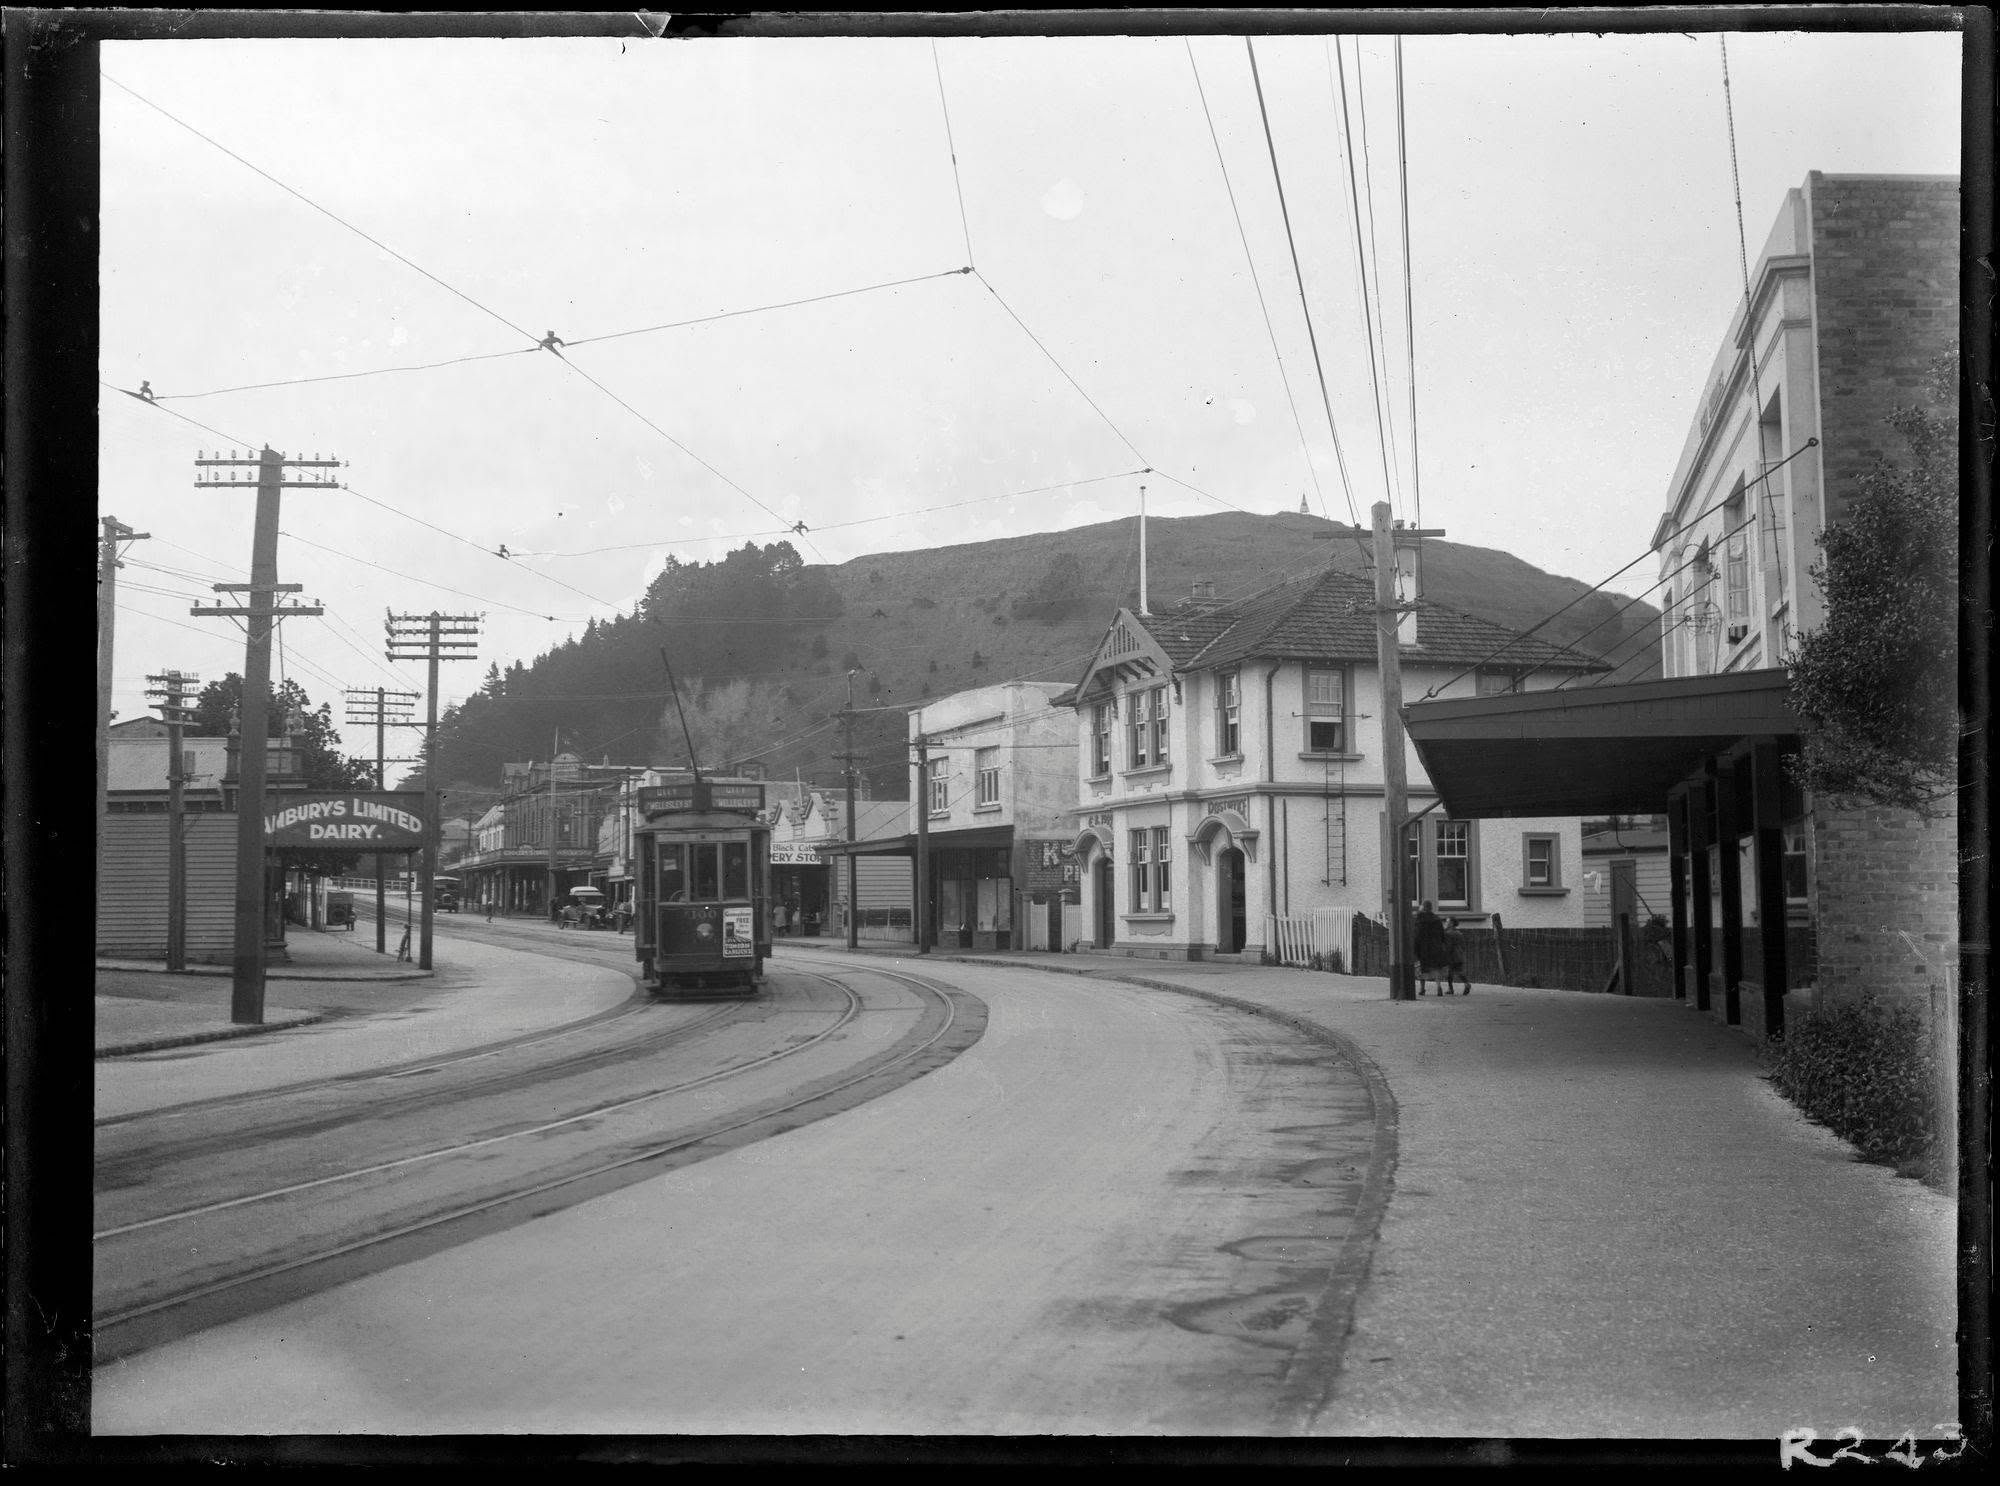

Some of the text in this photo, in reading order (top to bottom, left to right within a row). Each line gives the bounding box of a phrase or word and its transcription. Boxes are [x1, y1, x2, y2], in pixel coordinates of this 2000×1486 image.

[353, 798, 422, 833] LIMITED
[310, 824, 383, 839] DAIRY.
[773, 844, 794, 852] Black
[772, 852, 793, 862] ERY
